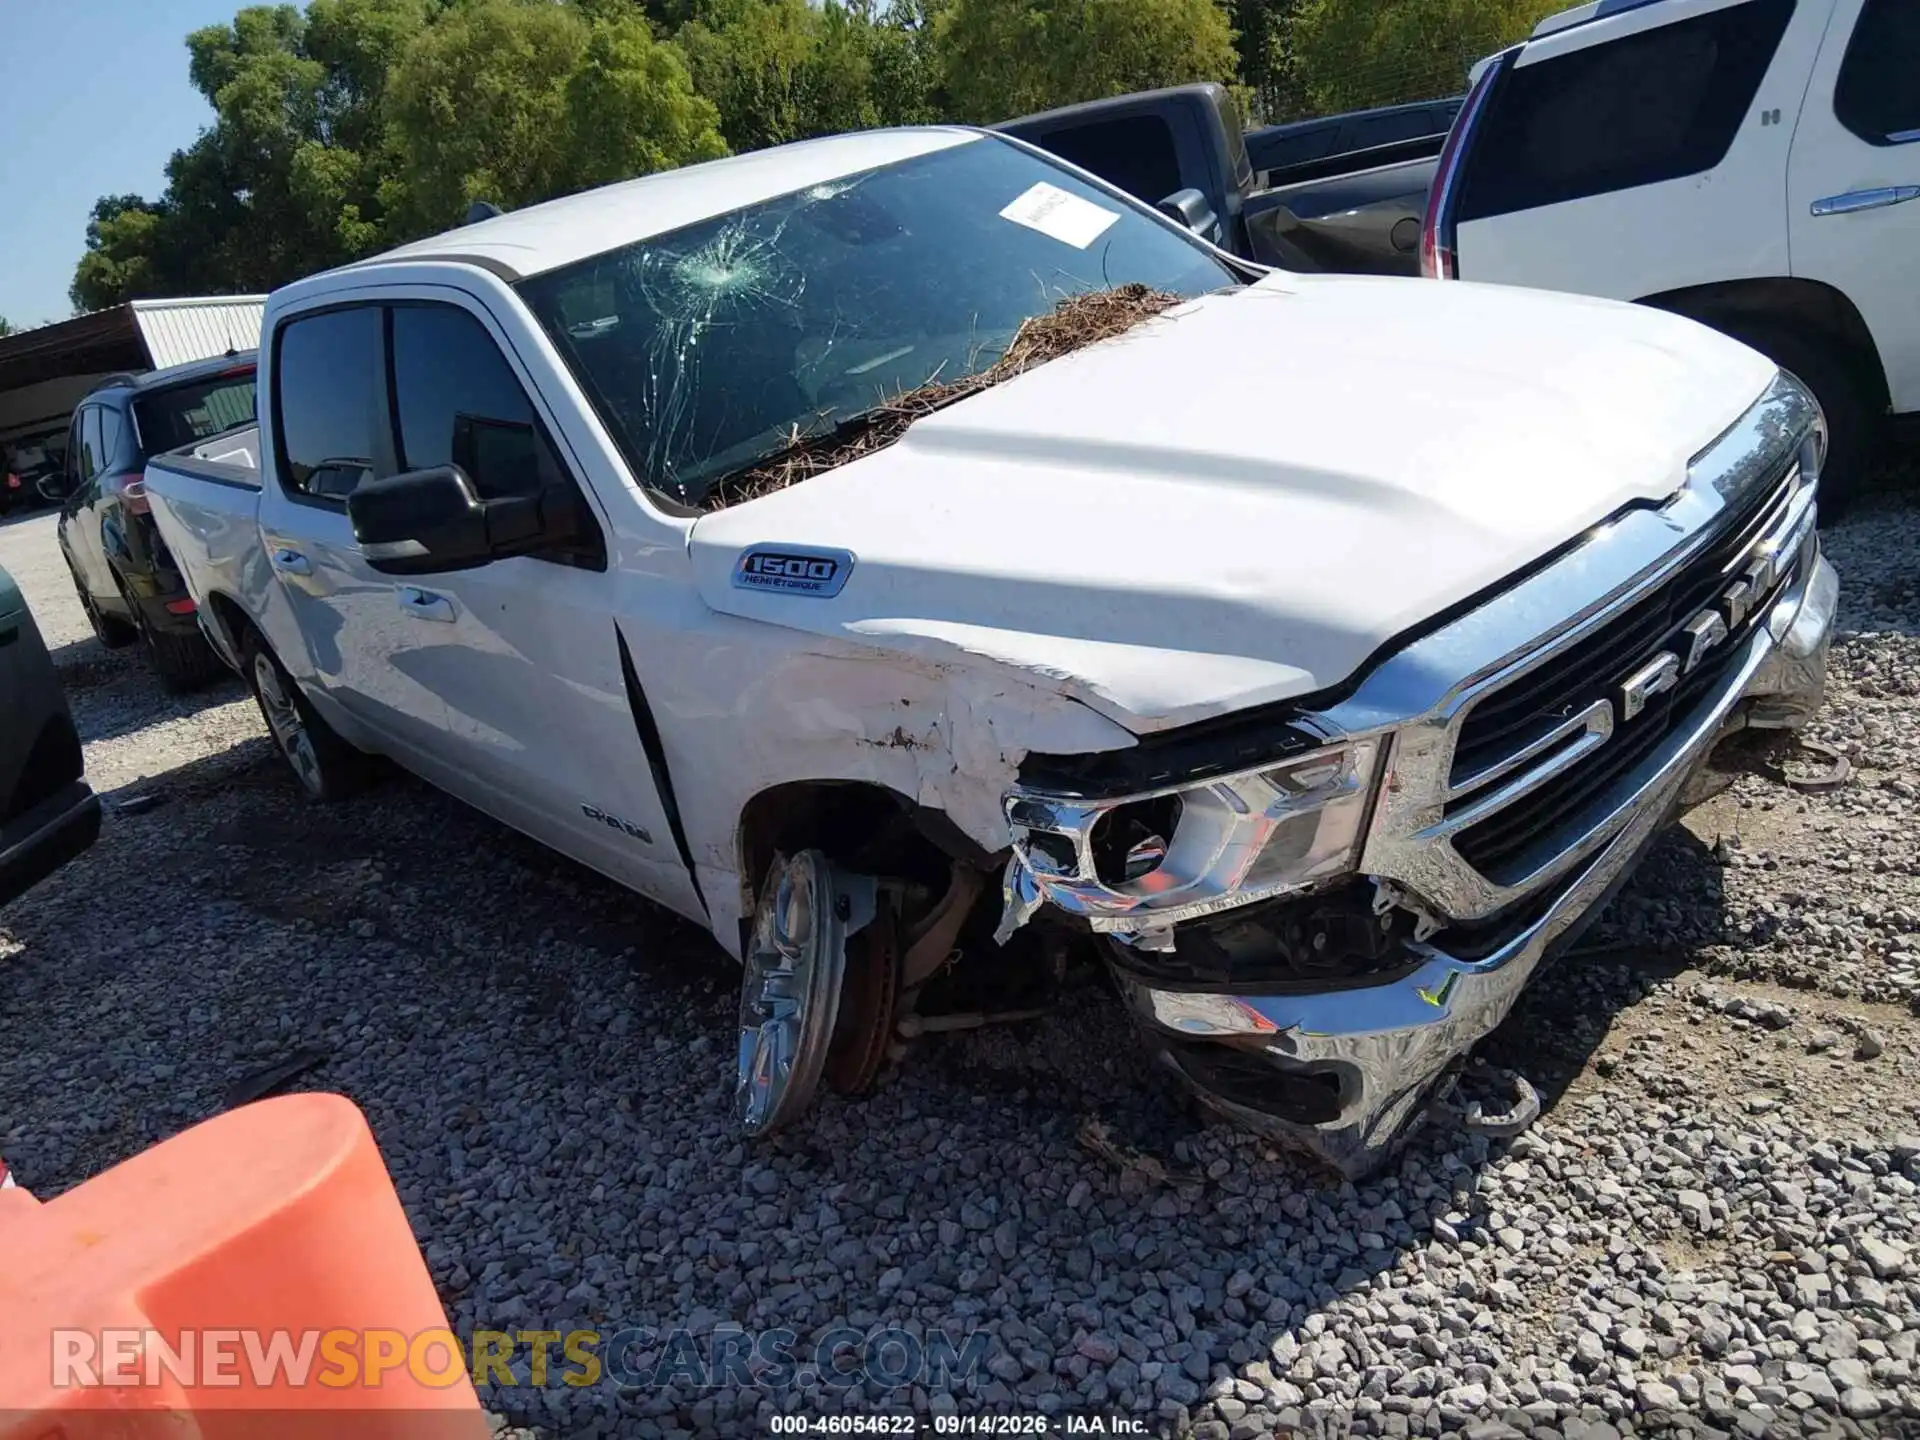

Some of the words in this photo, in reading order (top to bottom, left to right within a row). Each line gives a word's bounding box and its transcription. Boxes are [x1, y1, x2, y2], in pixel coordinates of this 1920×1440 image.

[751, 556, 833, 579] 1500
[743, 573, 772, 586] HEMI
[1618, 556, 1768, 722] RAM
